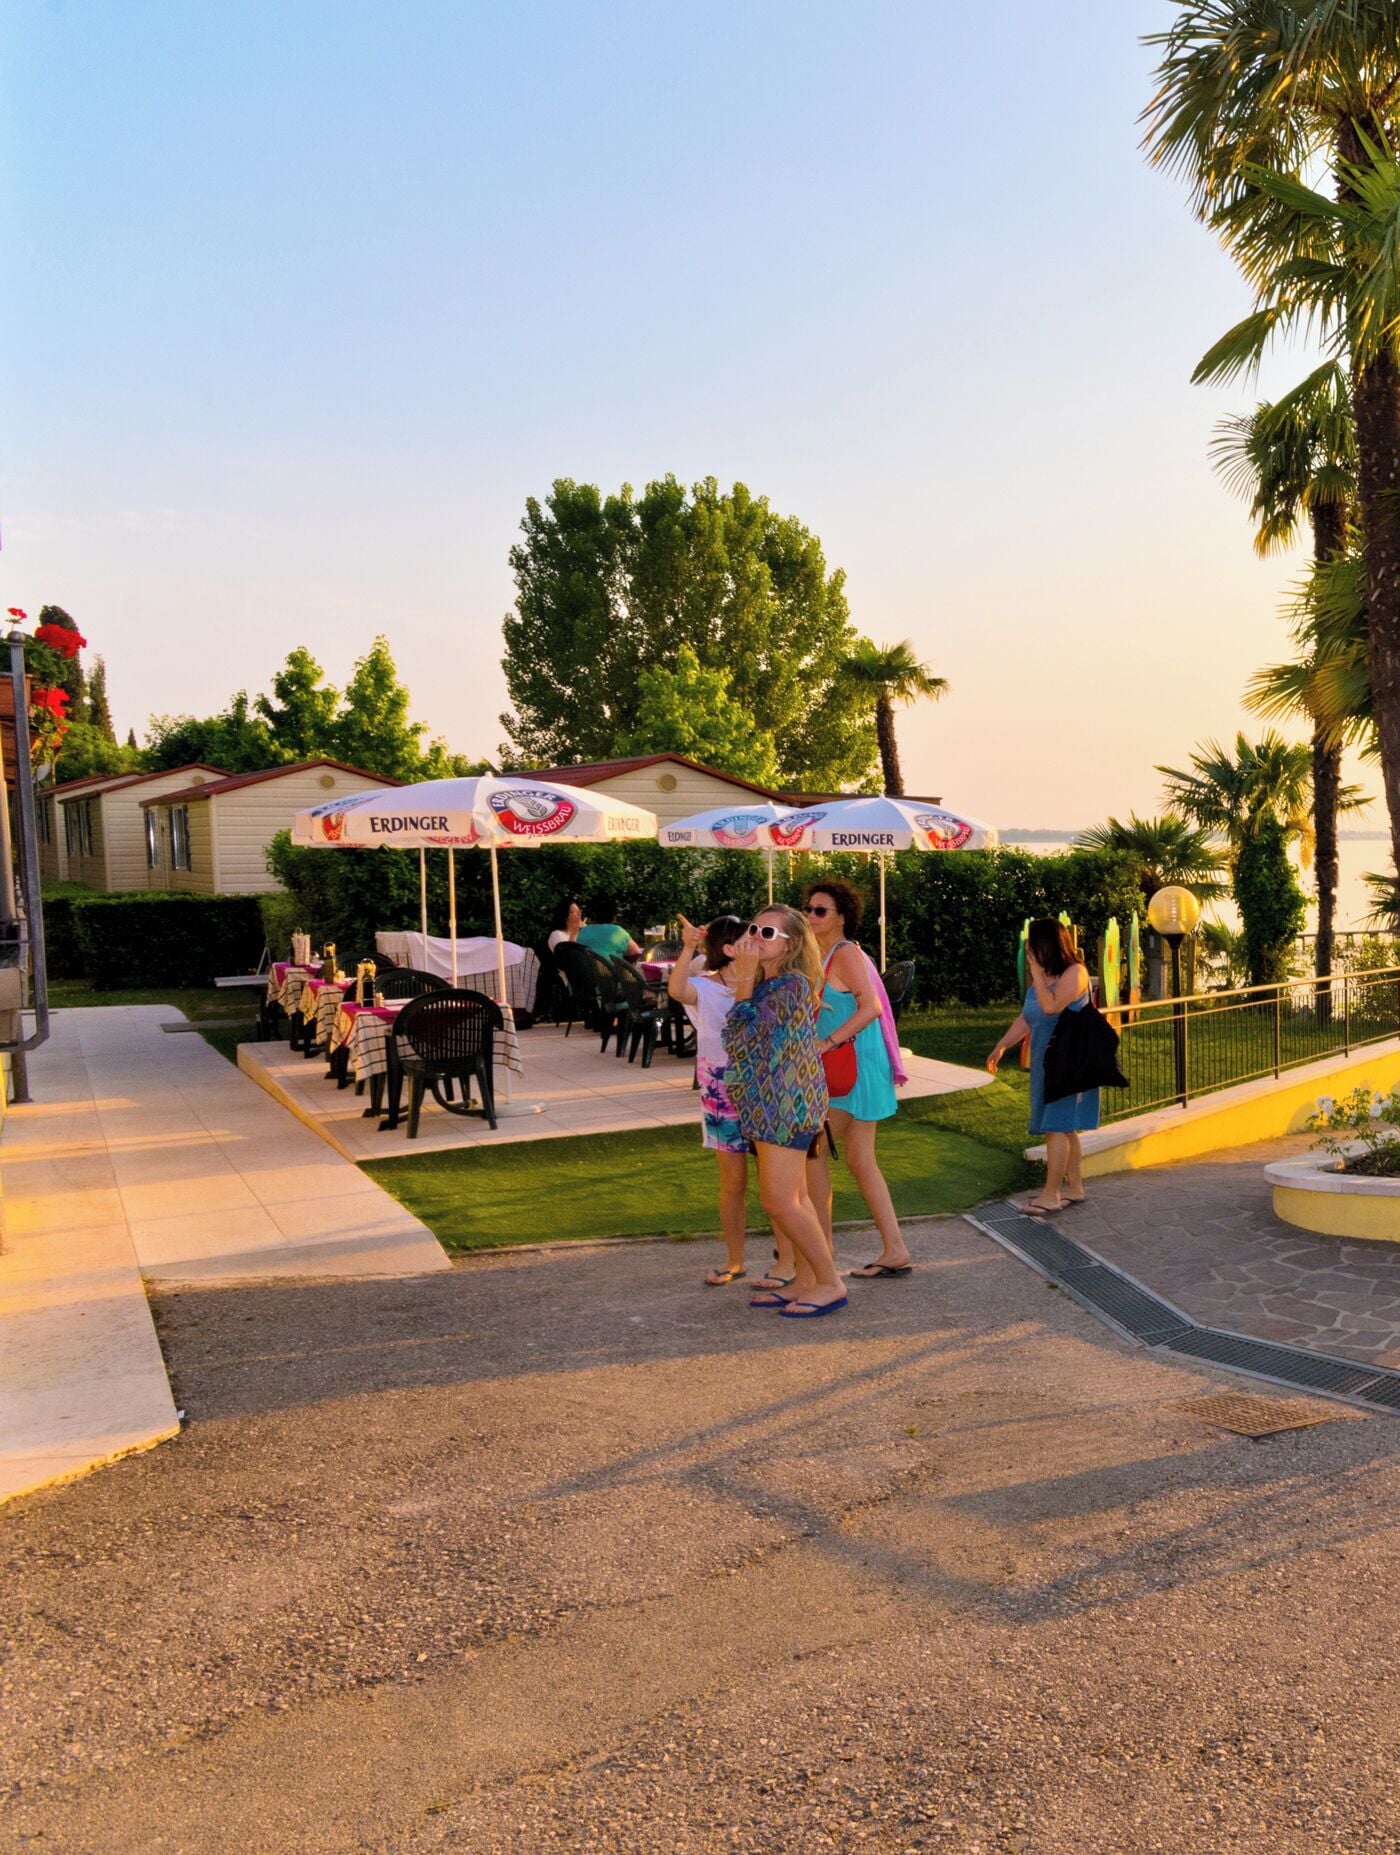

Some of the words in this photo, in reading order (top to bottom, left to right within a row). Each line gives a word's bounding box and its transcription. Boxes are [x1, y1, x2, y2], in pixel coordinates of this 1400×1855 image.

[492, 790, 556, 808] ERDINGER
[370, 816, 449, 833] ERDINGER
[831, 832, 895, 846] ERDINGER
